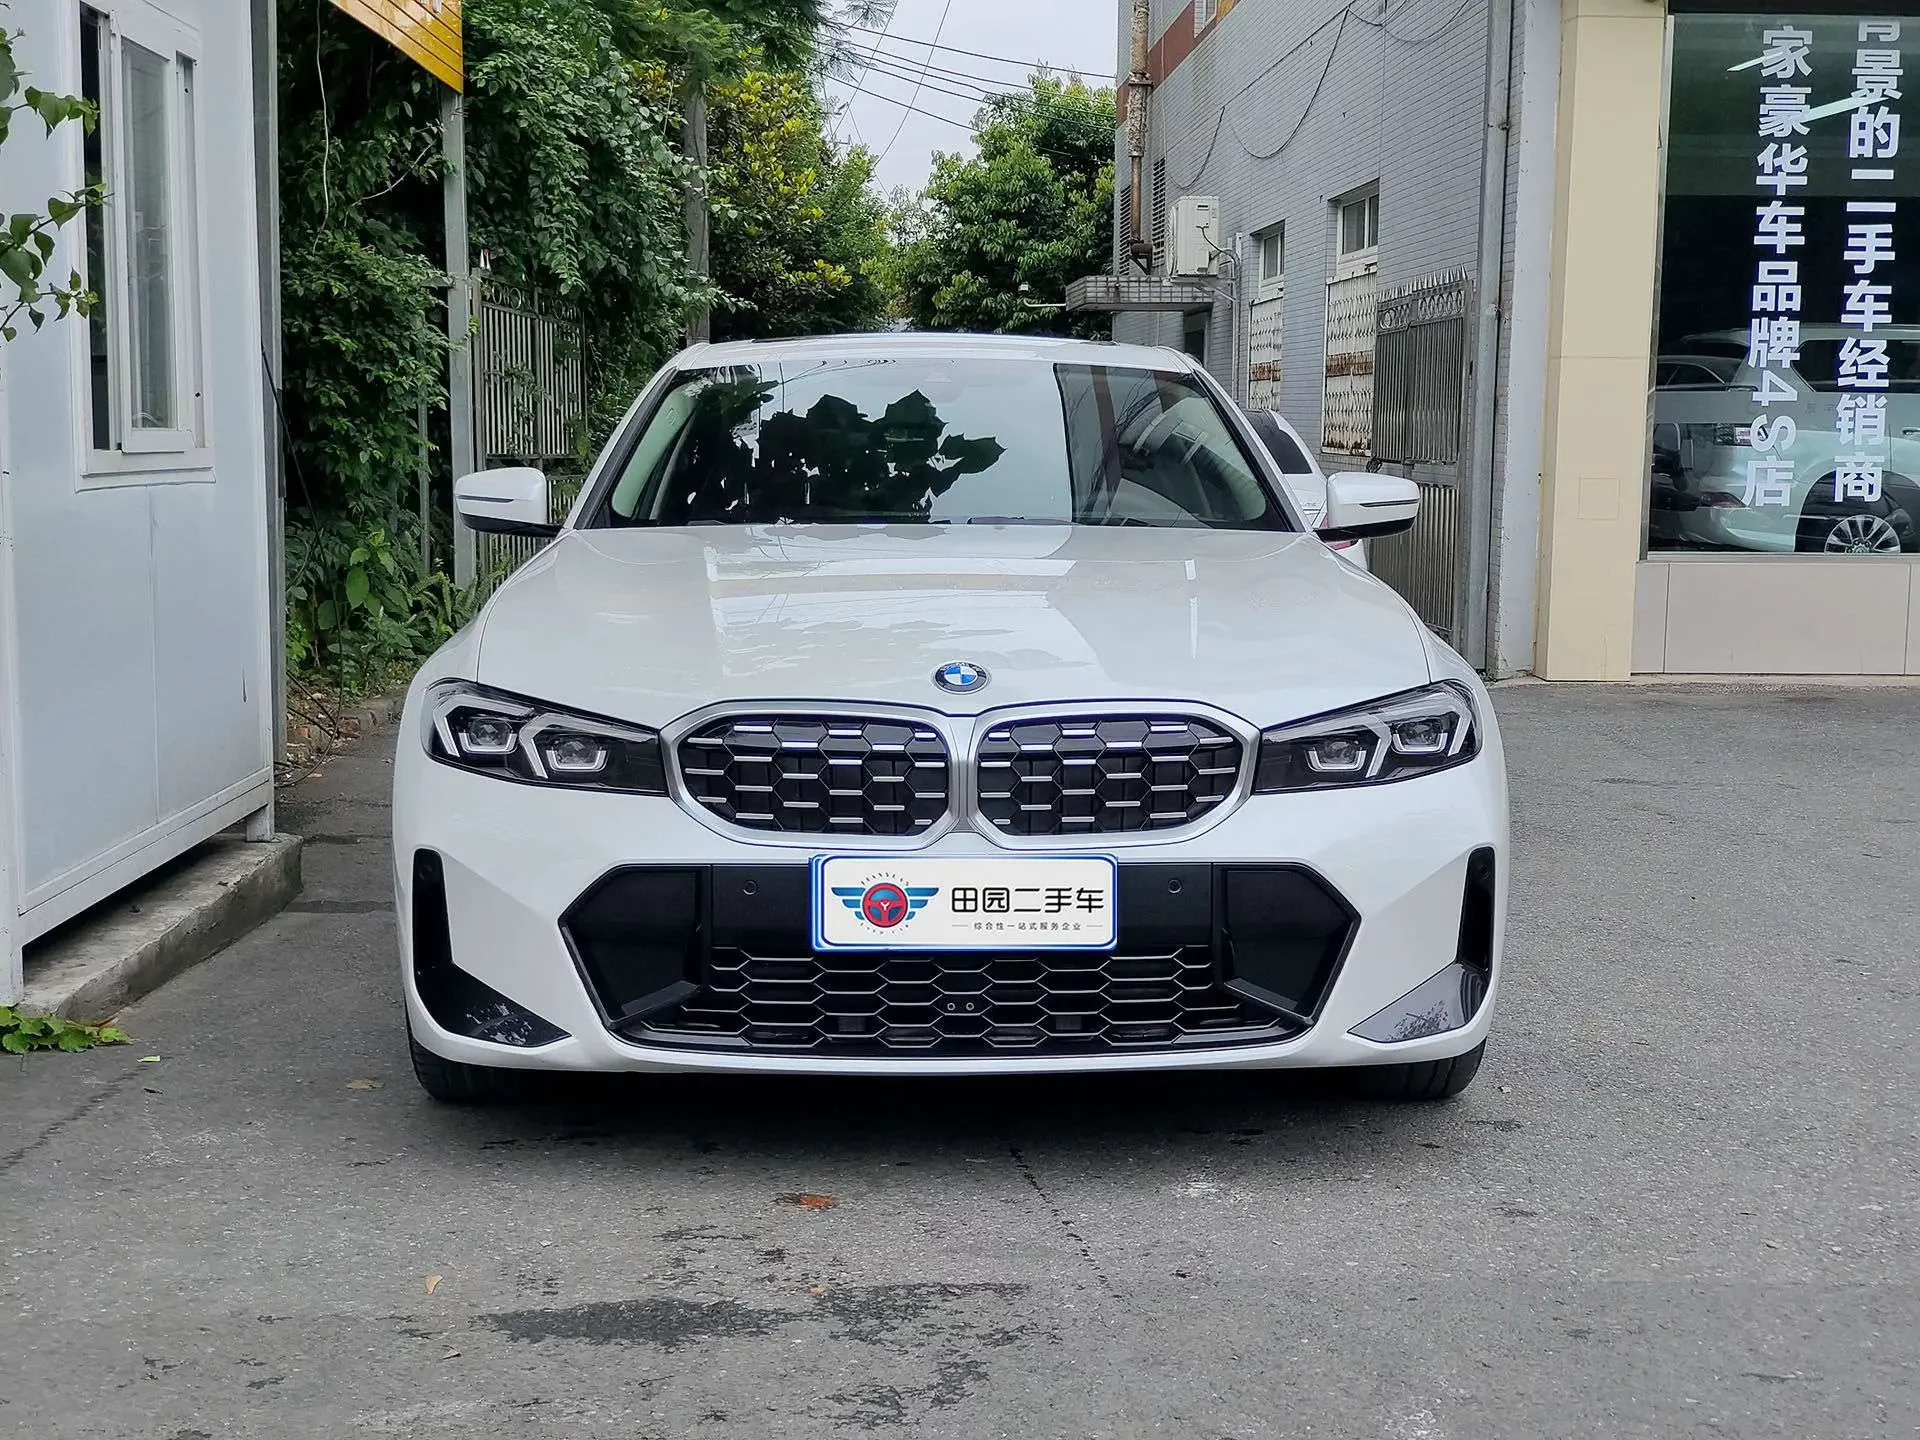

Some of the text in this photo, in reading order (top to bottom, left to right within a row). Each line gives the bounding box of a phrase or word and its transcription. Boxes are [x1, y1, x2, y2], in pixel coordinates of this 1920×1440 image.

[1740, 25, 1813, 507] 家豪华车品牌4S店
[951, 887, 1104, 913] 田园二手车
[974, 922, 1081, 931] 综合性一站式服务企业
